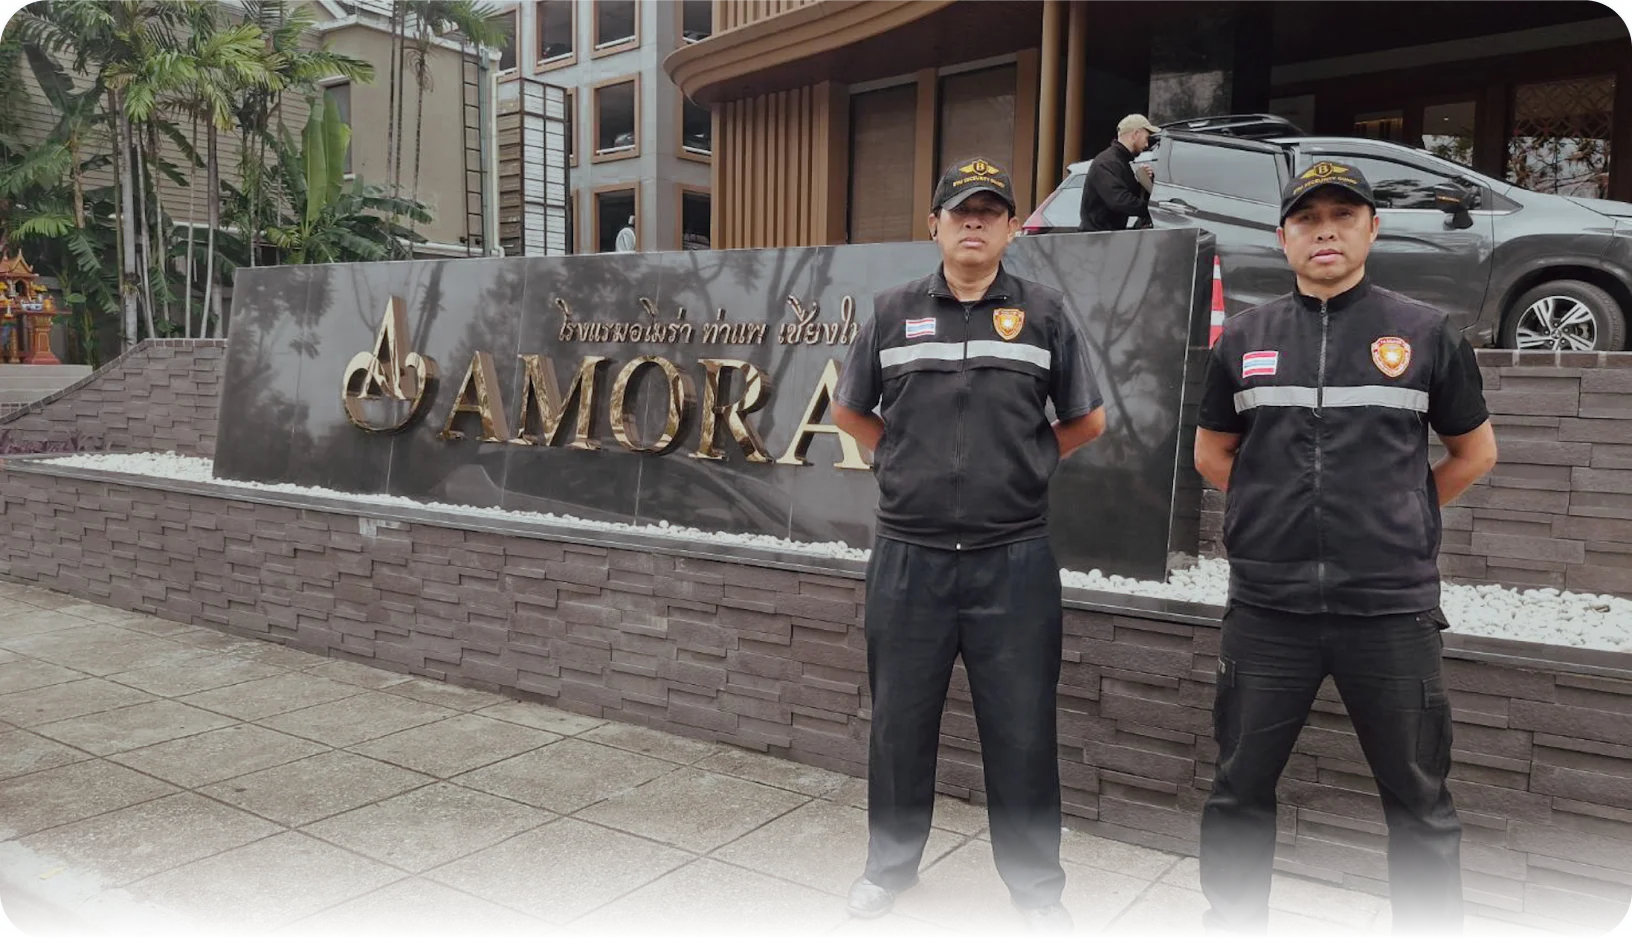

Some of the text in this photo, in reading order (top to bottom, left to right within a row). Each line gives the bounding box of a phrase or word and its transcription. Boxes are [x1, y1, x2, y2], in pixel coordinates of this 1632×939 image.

[976, 162, 985, 171] B
[1318, 164, 1328, 174] B
[702, 307, 767, 345] ท่าแพ
[778, 294, 863, 345] เชียงใ
[435, 350, 873, 470] AMORA
